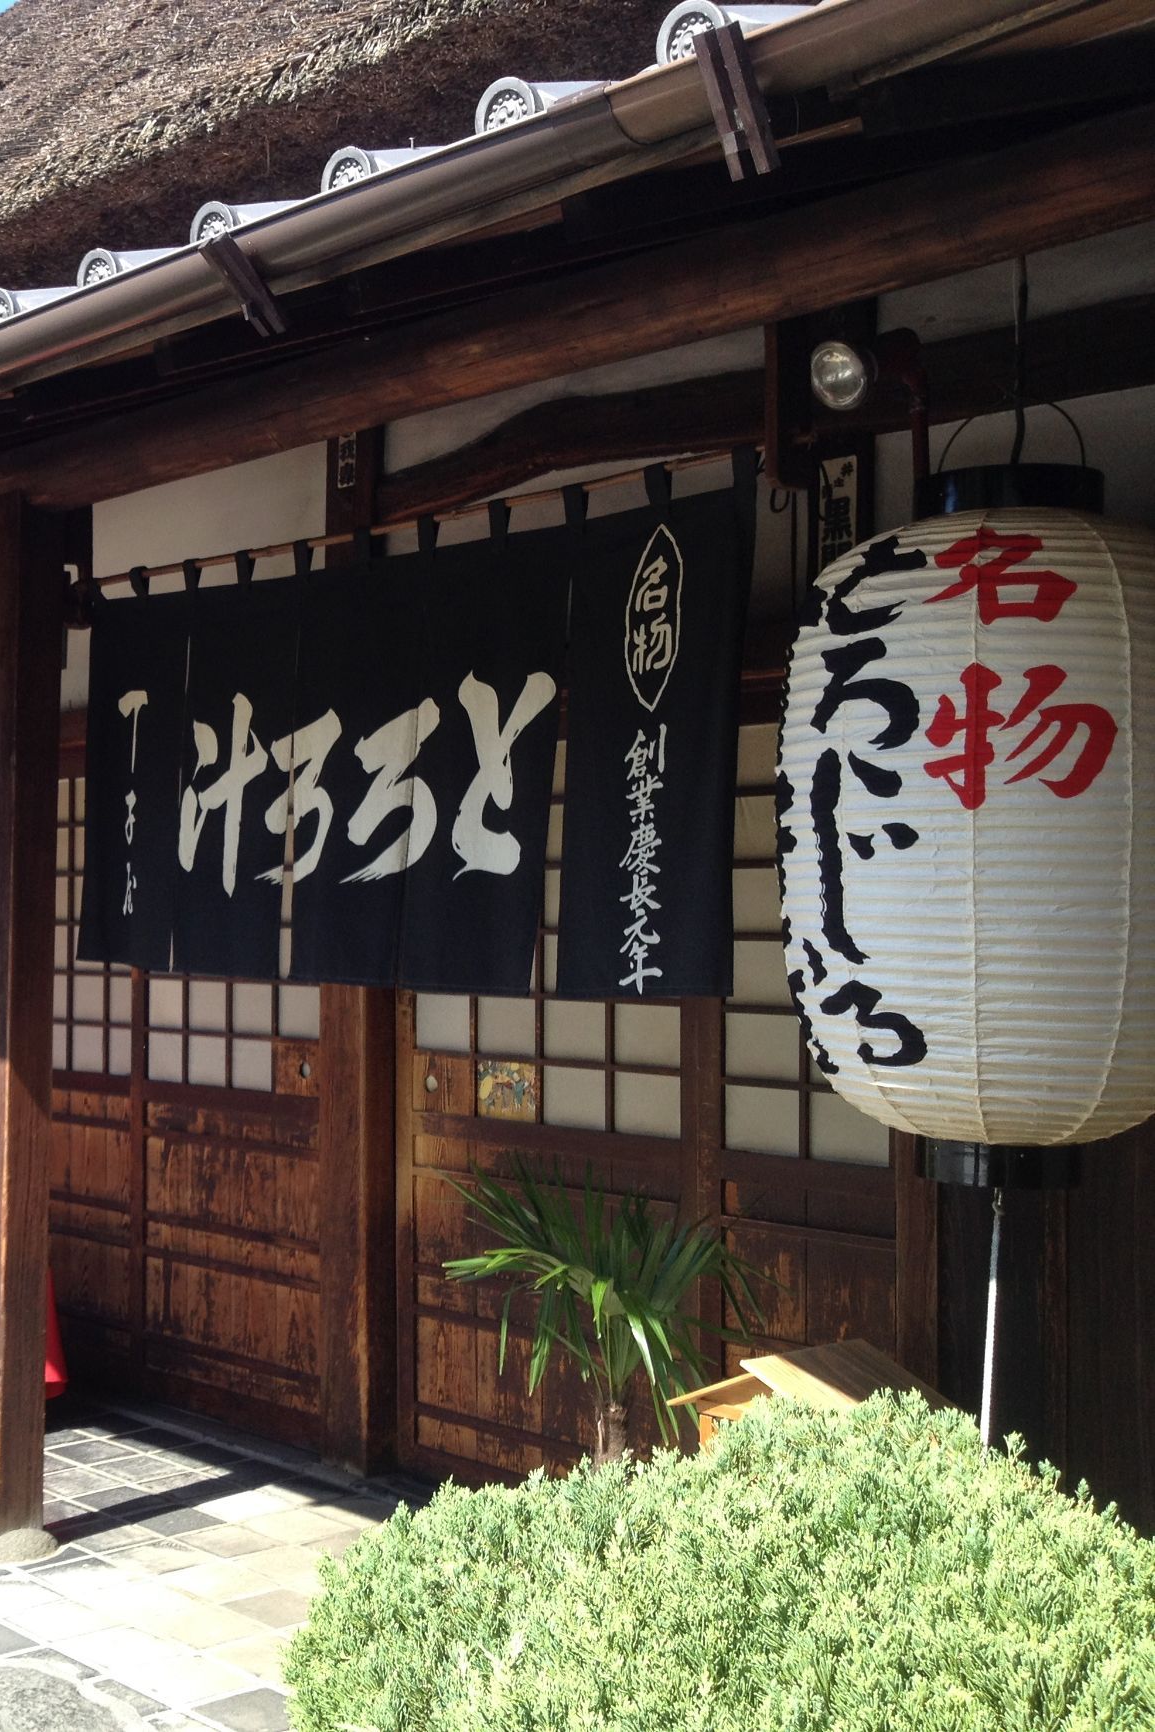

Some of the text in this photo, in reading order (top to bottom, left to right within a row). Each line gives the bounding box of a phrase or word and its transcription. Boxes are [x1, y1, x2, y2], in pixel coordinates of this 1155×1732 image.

[633, 555, 673, 675] 名物
[922, 528, 1118, 810] 名物
[618, 722, 668, 996] 創業慶長元年
